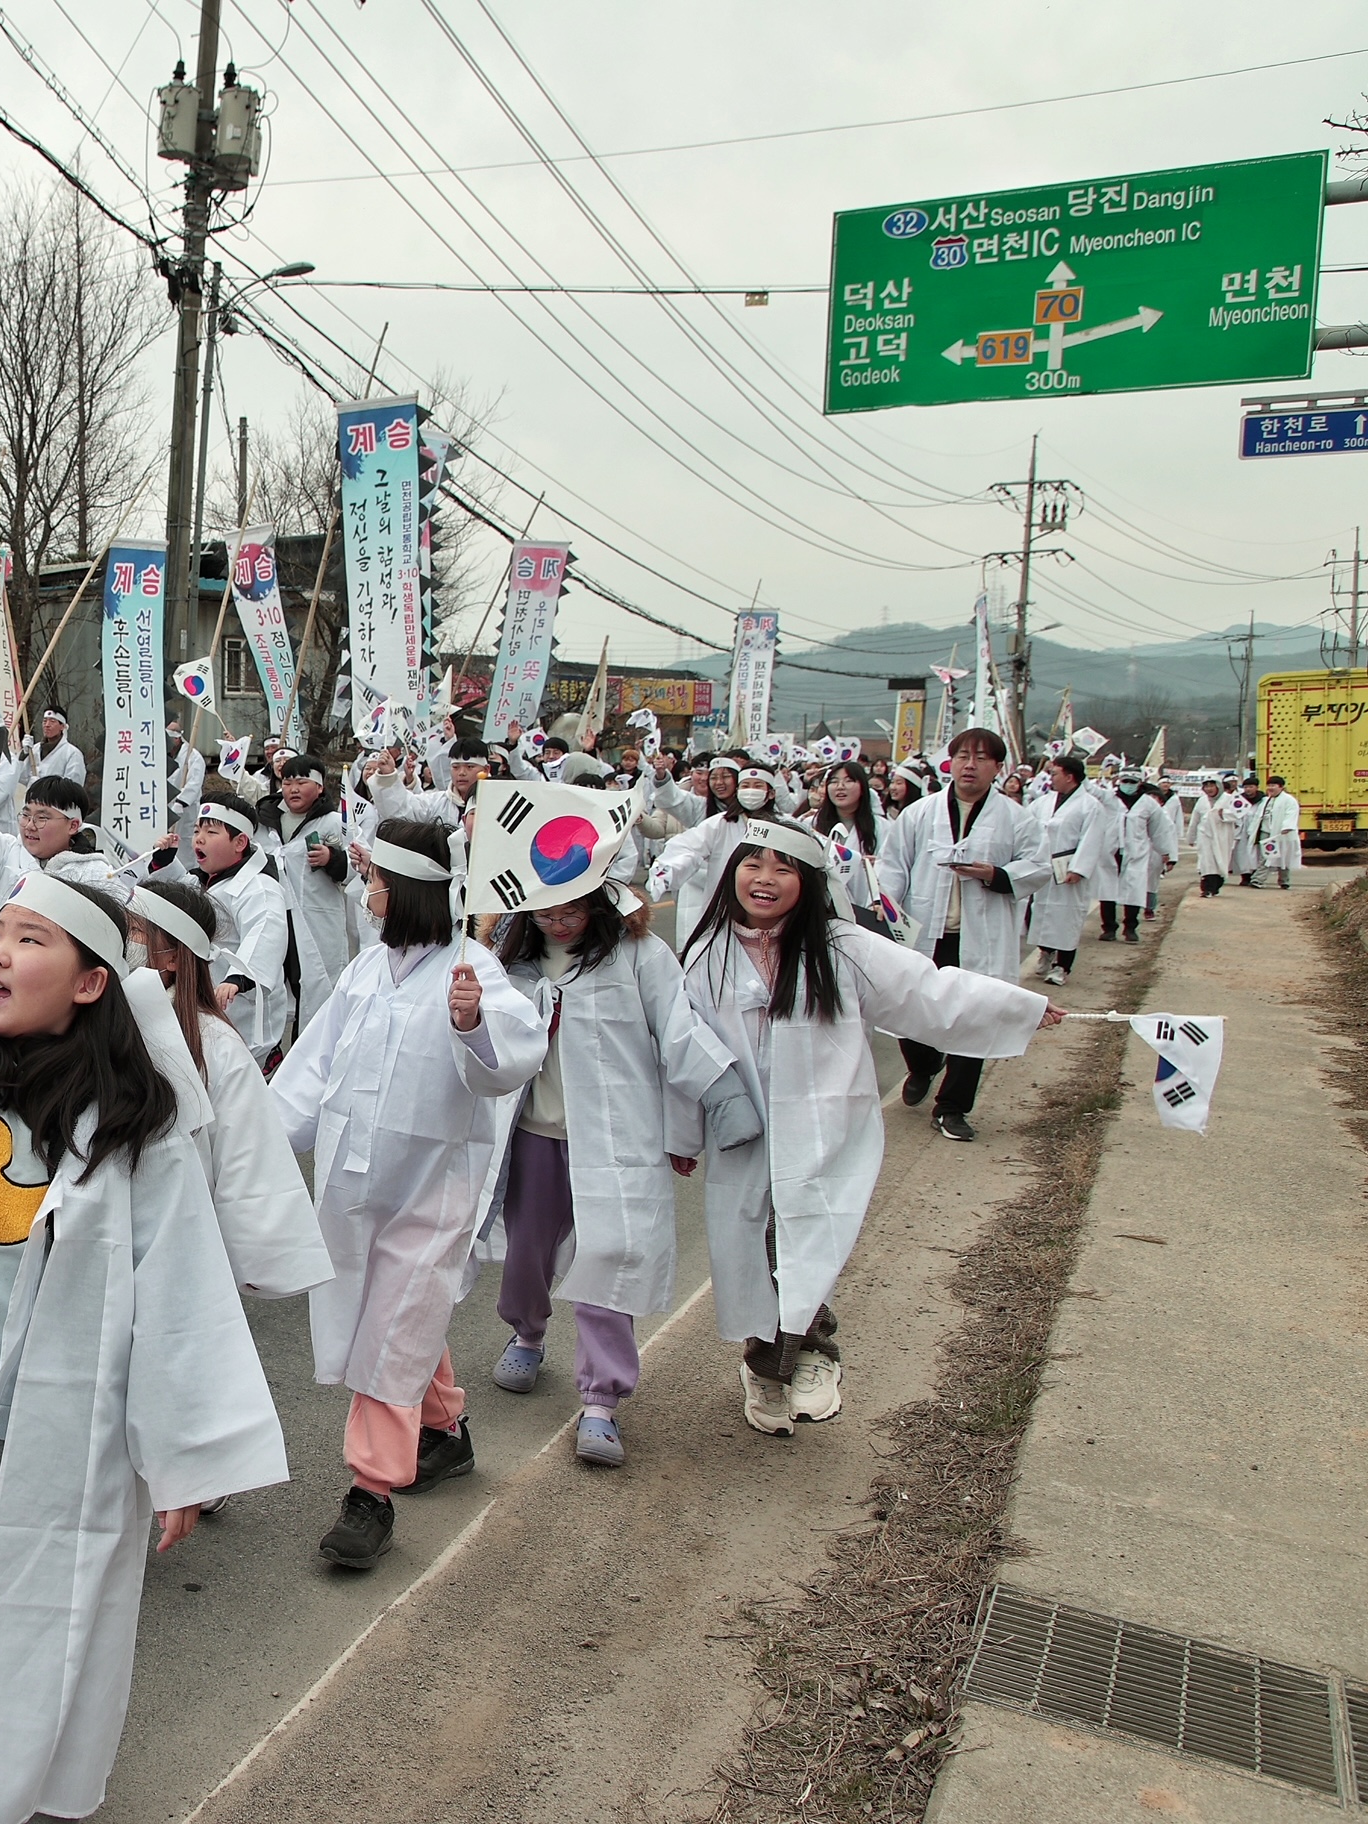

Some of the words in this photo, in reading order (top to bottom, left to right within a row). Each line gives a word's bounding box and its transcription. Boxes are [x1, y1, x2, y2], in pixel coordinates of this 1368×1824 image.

[891, 213, 918, 235] 32
[930, 200, 989, 232] 서산
[990, 204, 1061, 227] Seosan
[1068, 182, 1129, 216] 당진
[1133, 186, 1214, 211] Dangjin
[936, 245, 961, 266] 30
[1070, 225, 1176, 255] Myeoncheon
[1181, 221, 1202, 241] IC
[843, 277, 913, 310] 덕산
[1221, 264, 1302, 303] 면천
[844, 313, 915, 333] Deoksan
[1038, 293, 1081, 319] 70
[1208, 301, 1310, 331] Myeoncheon
[839, 332, 908, 366] 고덕
[981, 335, 1029, 360] 619
[840, 366, 901, 387] Godeok
[1025, 370, 1081, 390] 300m
[347, 417, 413, 455] 계승
[1255, 438, 1333, 454] Hancheon-ro
[1260, 415, 1329, 439] 한천로
[375, 468, 392, 535] 그날의
[349, 499, 371, 572] 정신을
[401, 480, 412, 565] 면천공립보통학교
[112, 562, 161, 597] 계승
[234, 553, 274, 586] 계승
[377, 546, 398, 624] 함성과!
[356, 581, 377, 680] 기억하자!
[402, 582, 417, 667] 학생독립만세운동
[112, 618, 133, 718] 후손들이
[136, 609, 154, 708] 선열들이
[254, 633, 284, 700] 조국통일
[407, 669, 419, 690] 재현
[117, 731, 133, 754] 꽃
[139, 719, 155, 767] 지킨
[112, 766, 132, 839] 피우자
[139, 780, 158, 829] 나라
[752, 826, 770, 839] 만세
